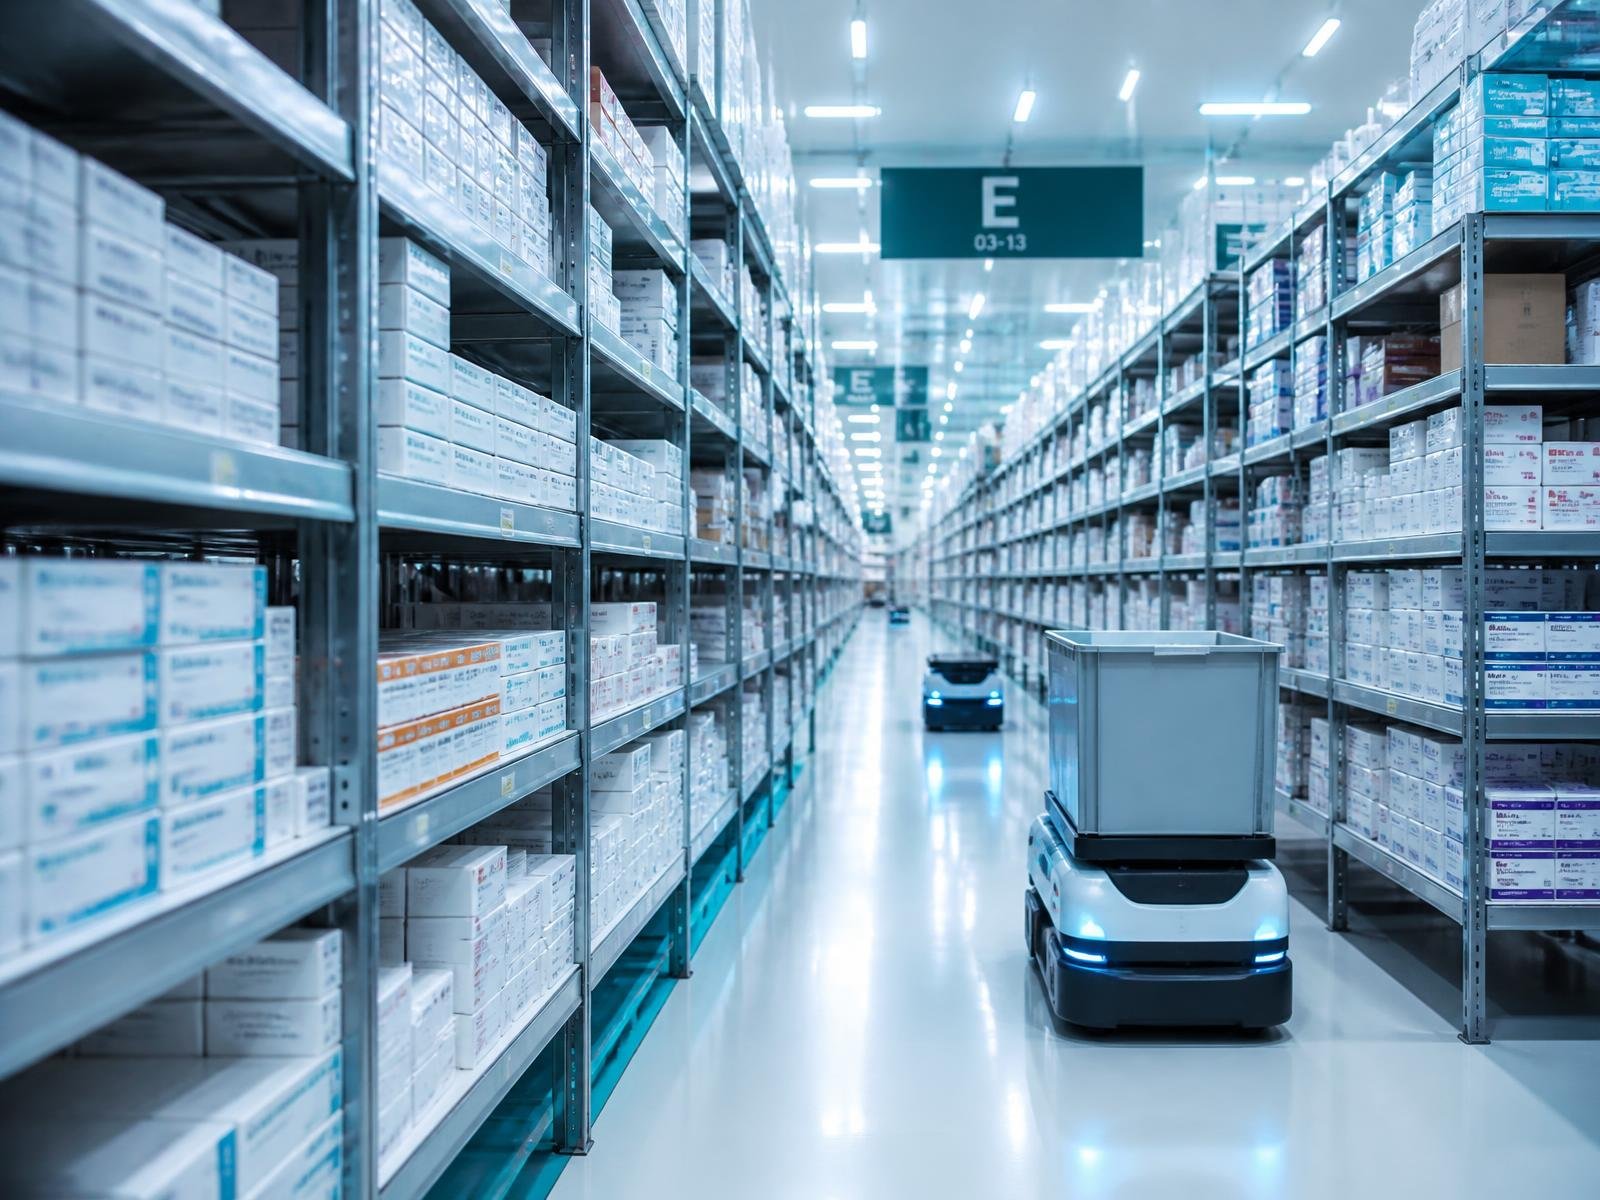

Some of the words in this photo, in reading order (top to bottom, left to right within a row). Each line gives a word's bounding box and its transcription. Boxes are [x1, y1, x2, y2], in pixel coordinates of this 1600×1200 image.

[982, 176, 1019, 228] E
[974, 233, 1027, 251] 03-13
[851, 370, 873, 393] E
